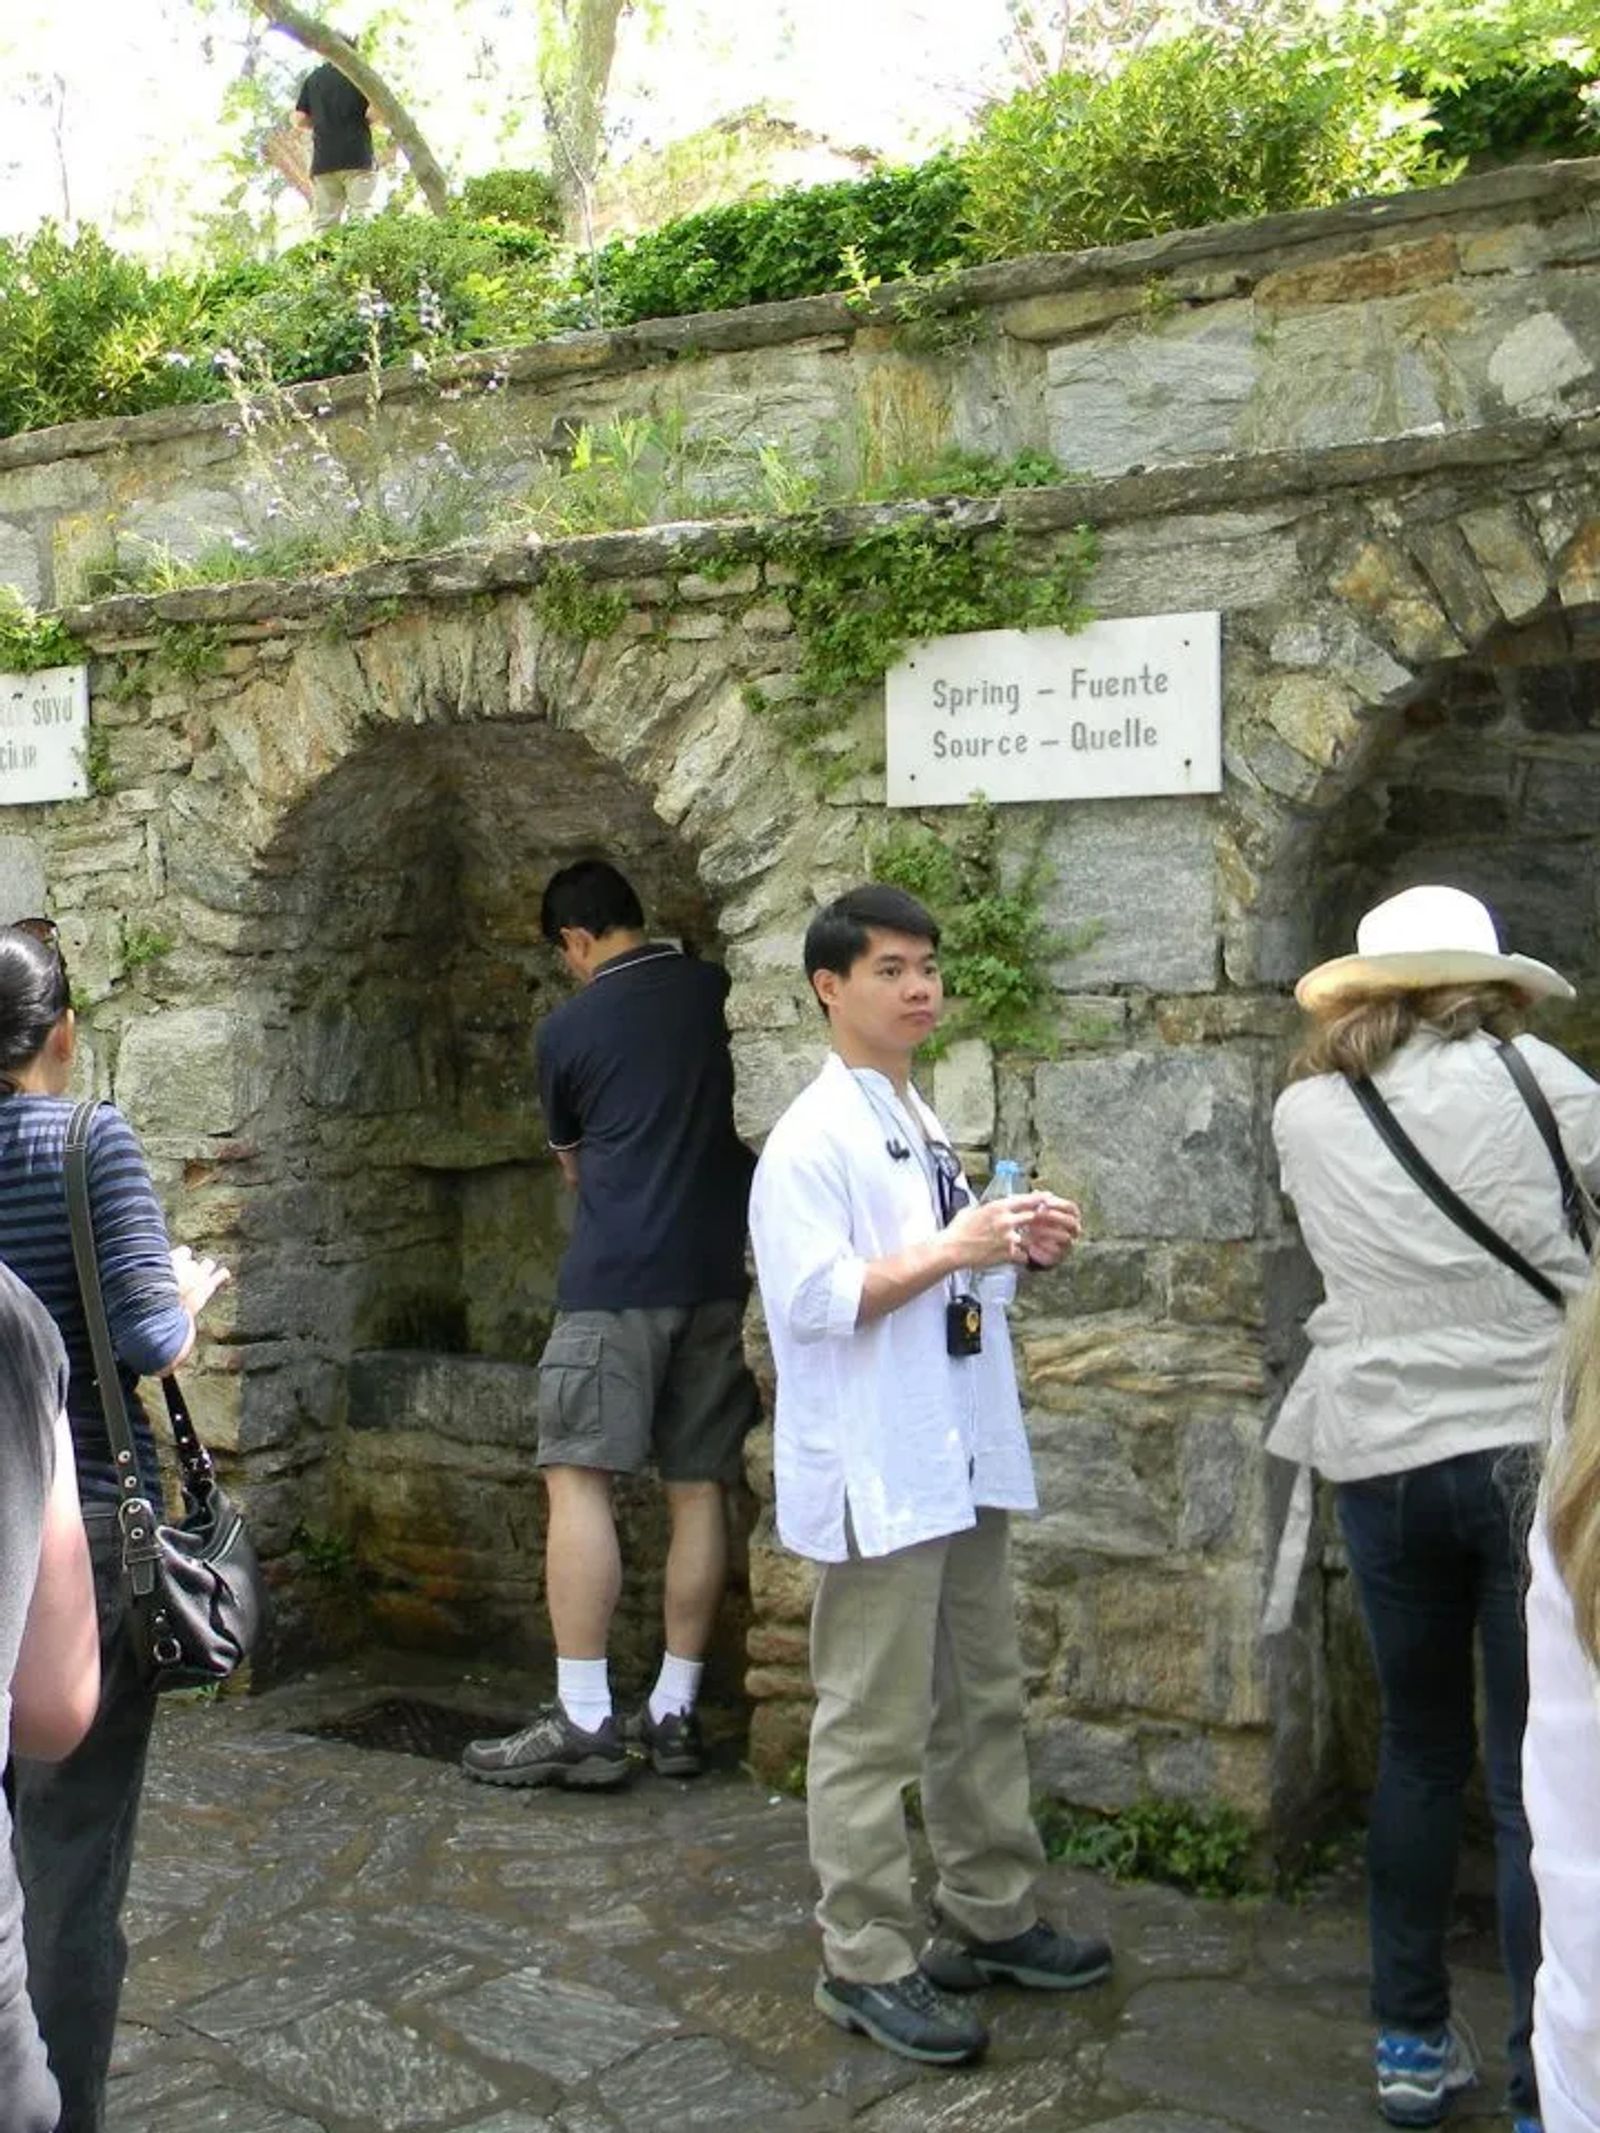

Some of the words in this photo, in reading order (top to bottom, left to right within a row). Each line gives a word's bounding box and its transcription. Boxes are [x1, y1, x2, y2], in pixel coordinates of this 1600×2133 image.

[932, 679, 1020, 715] Spring
[1071, 663, 1169, 699] Fuente
[933, 730, 1029, 759] Source
[1071, 718, 1157, 751] Quelle
